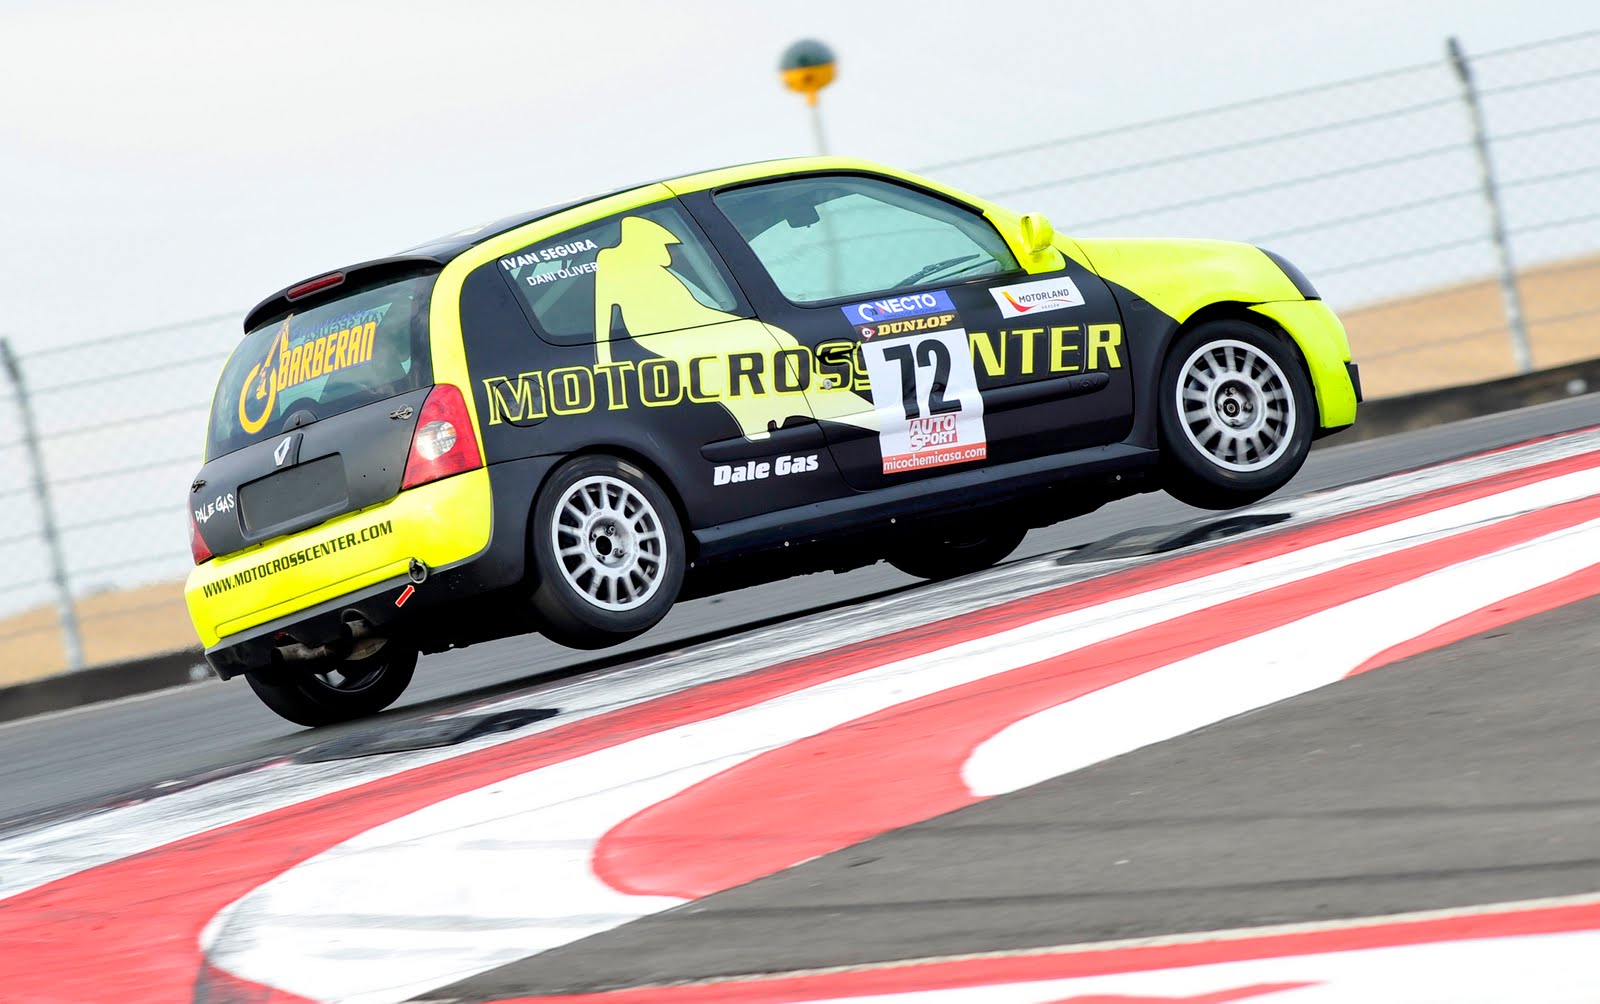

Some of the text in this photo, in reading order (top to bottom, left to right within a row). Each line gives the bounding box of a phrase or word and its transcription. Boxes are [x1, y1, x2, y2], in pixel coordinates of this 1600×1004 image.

[501, 238, 598, 271] IVAN SEGURA
[526, 260, 600, 286] DANI OLIVER
[1018, 288, 1070, 304] MOTORLAND
[877, 314, 952, 337] DUNLOP
[276, 320, 377, 392] BARBERAN
[482, 322, 1123, 426] MOTOCROSNTER
[882, 338, 963, 420] 72
[908, 414, 957, 437] AUTO
[909, 430, 957, 451] SPORT
[713, 455, 819, 486] Dale Gas
[883, 446, 986, 472] micochemicasa.com
[194, 493, 235, 524] DALE GAS
[202, 520, 394, 598] WWW.MOTOCROSSCENTER.COM
